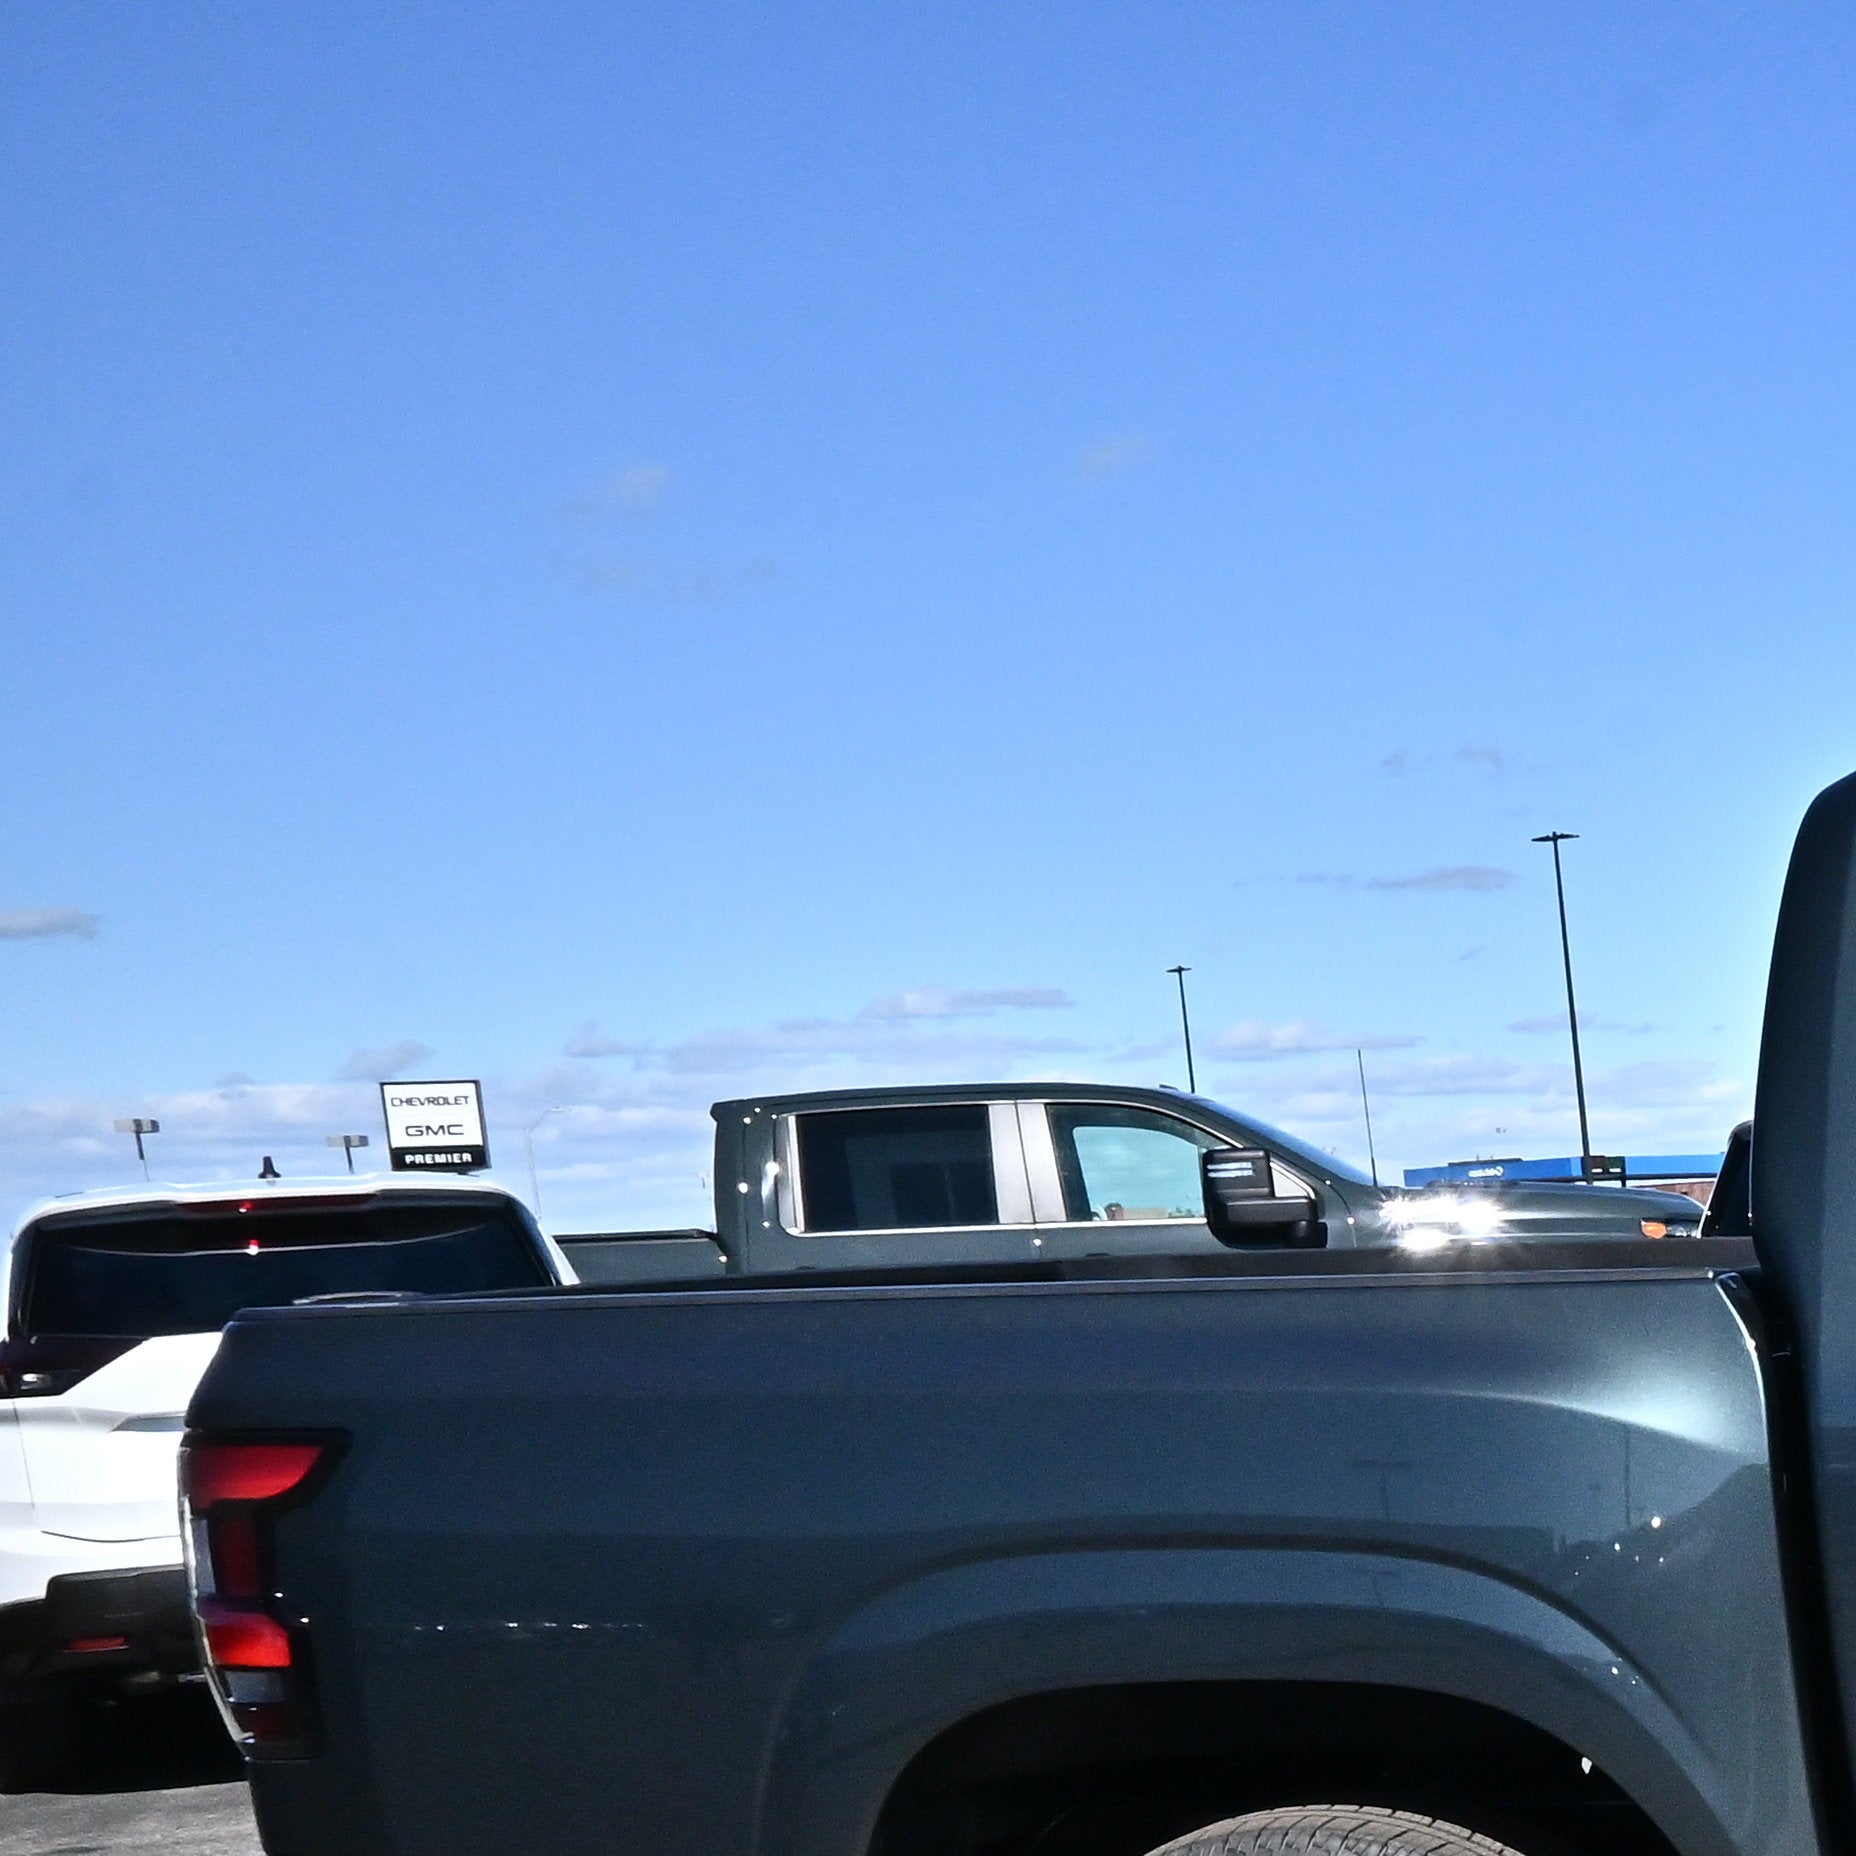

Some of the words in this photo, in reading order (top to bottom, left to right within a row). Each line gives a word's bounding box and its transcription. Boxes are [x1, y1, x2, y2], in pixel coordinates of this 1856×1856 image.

[391, 1095, 469, 1107] CHEVROLET
[405, 1124, 464, 1137] GMC
[405, 1152, 473, 1165] PREMIER
